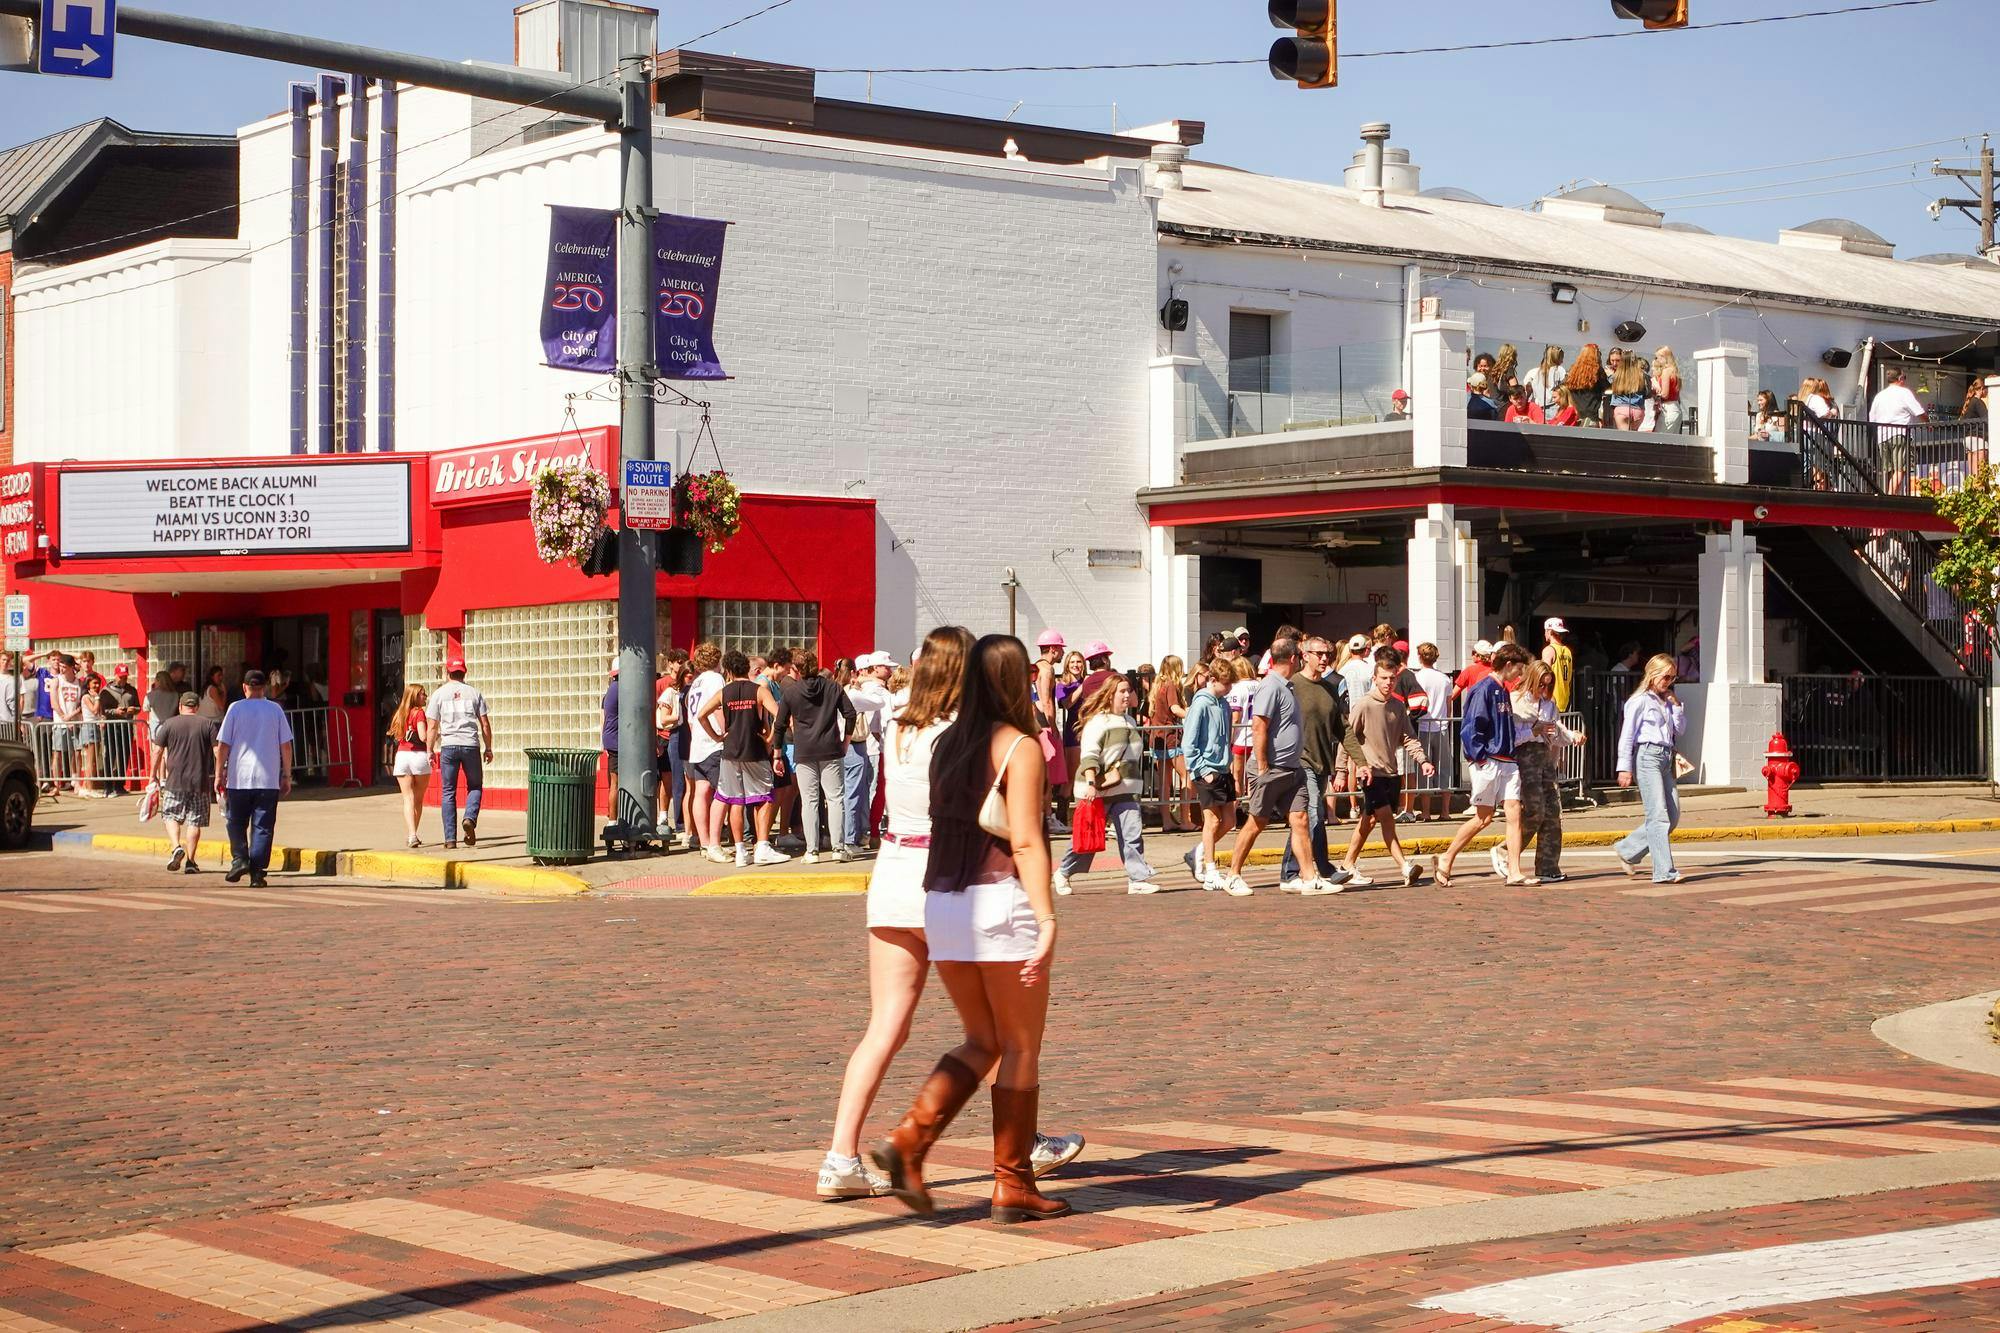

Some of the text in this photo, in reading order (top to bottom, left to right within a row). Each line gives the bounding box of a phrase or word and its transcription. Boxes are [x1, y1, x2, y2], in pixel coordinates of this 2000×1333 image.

[555, 242, 610, 258] Celebrating!
[657, 248, 716, 268] Celebrating!
[556, 272, 603, 284] AMERICA
[660, 278, 704, 292] AMERICA
[552, 284, 605, 312] 250
[658, 290, 704, 319] 250
[562, 330, 598, 344] City of
[670, 335, 698, 350] City of
[563, 346, 597, 358] Oxford
[435, 454, 506, 493] Brick
[635, 462, 662, 473] SNOW
[146, 475, 317, 492] WELCOME BACK ALUMNI
[632, 474, 664, 485] ROUTE
[629, 488, 669, 497] NO PARKING
[170, 493, 295, 509] BEAT THE CLOCK 1
[155, 510, 310, 526] MIAMI VS UCONN 3:30
[153, 526, 312, 542] HAPPY BIRTHDAY TORI
[64, 692, 77, 703] 25
[690, 692, 702, 717] 27
